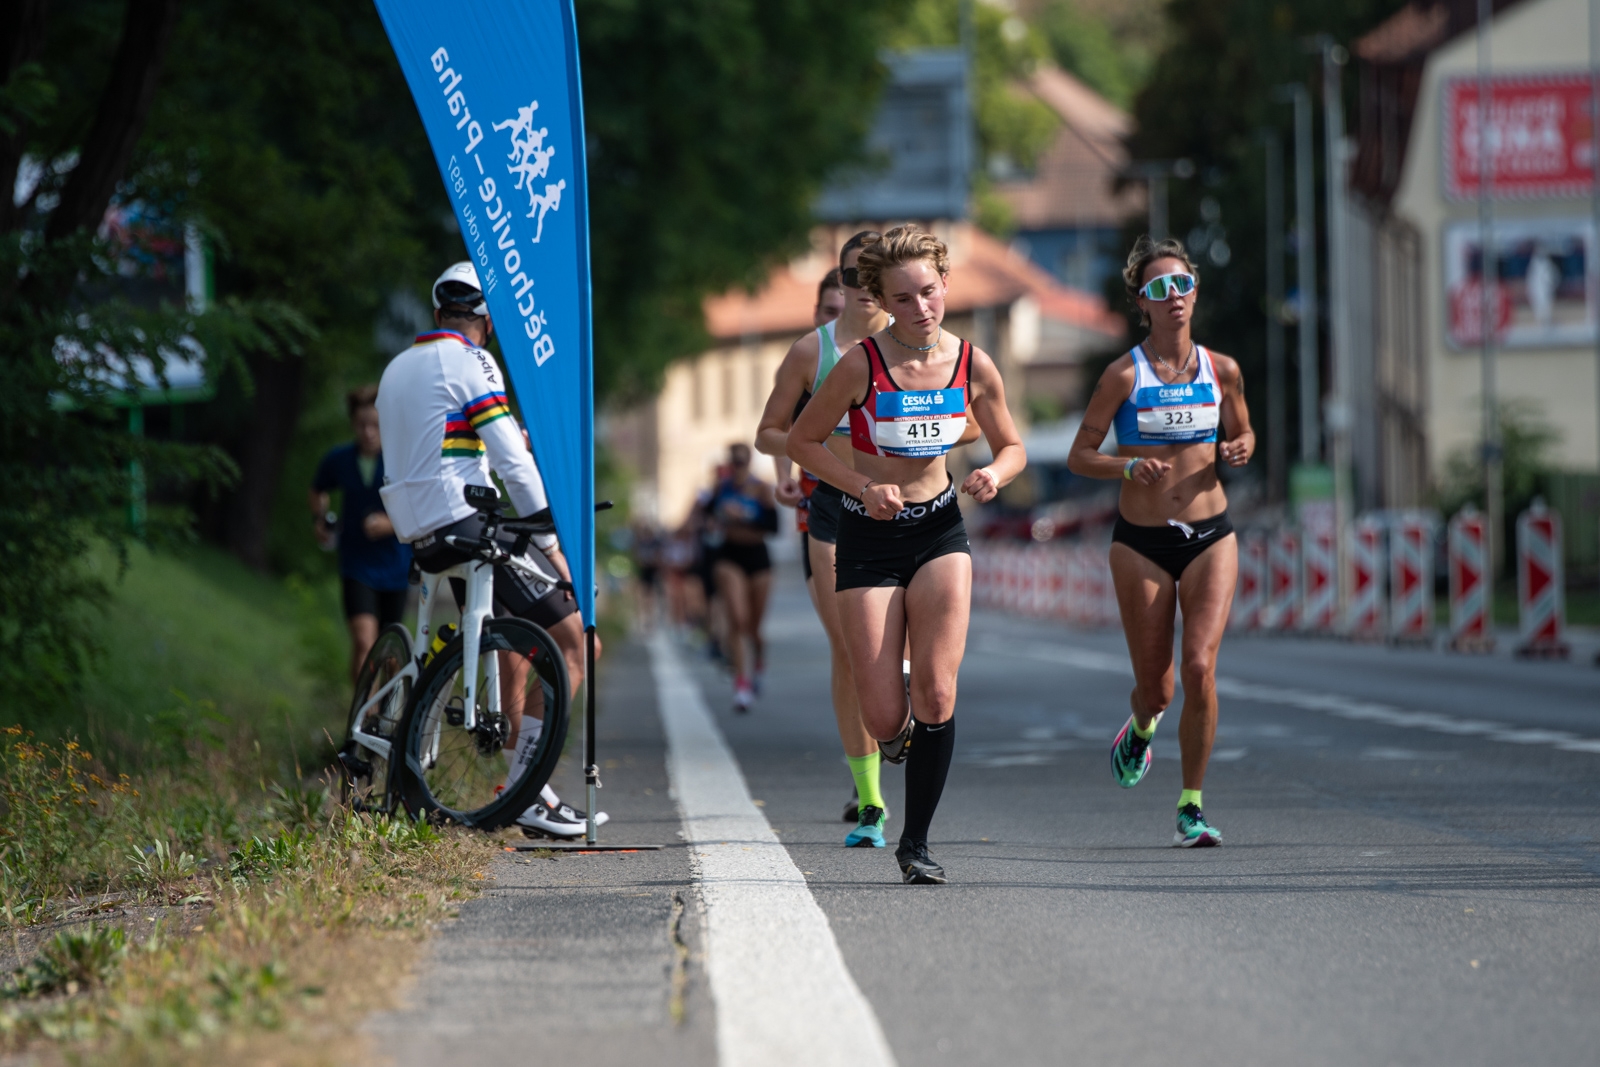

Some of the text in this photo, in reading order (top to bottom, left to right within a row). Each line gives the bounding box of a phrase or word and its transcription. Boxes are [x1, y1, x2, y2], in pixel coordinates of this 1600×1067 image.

[1159, 387, 1184, 398] ČESKÁ
[902, 394, 933, 406] ČESKÁ
[1164, 412, 1193, 425] 323
[907, 422, 940, 438] 415
[894, 506, 926, 520] RO
[931, 482, 956, 513] NIK
